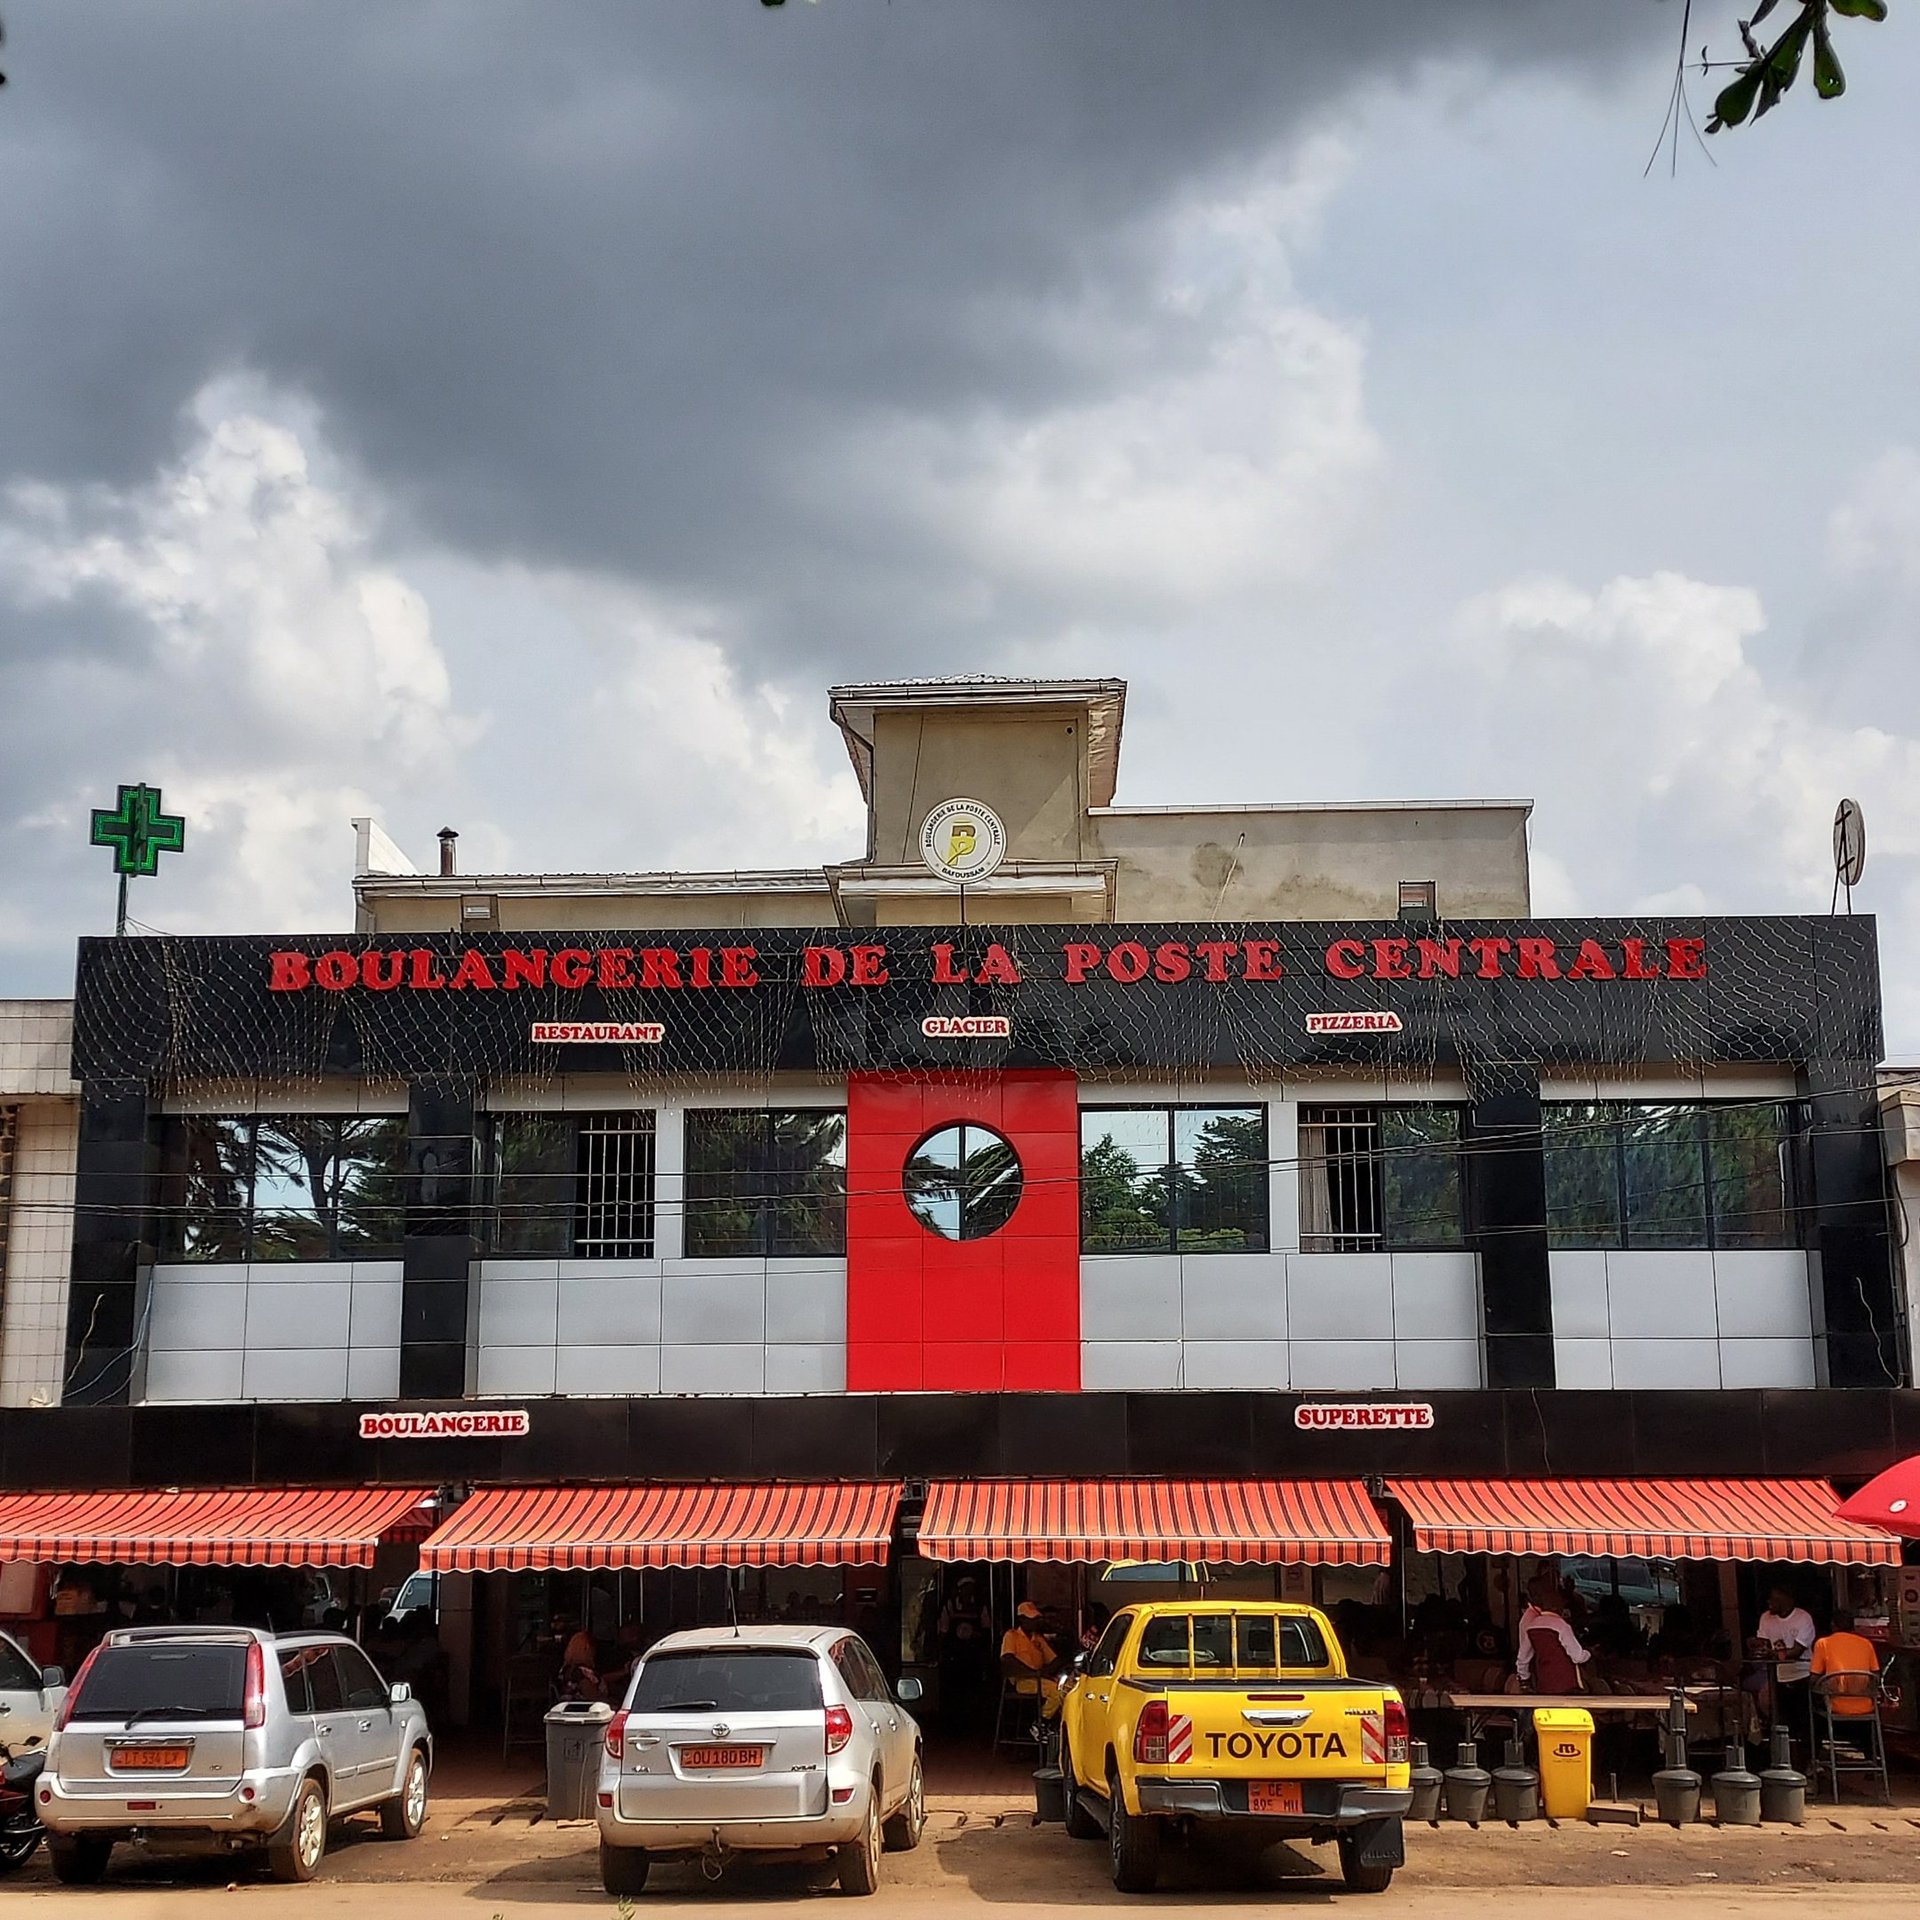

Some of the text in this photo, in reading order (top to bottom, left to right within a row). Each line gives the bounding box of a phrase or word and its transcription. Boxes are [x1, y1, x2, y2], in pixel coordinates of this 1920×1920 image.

[956, 803, 964, 811] LA
[941, 866, 986, 879] BAFOUSSAM
[268, 936, 1707, 991] BOULANGERIE DE LA POSTE CENTRALE
[923, 1018, 1008, 1035] GLACIER
[1308, 1014, 1400, 1031] PIZZERIA
[533, 1024, 662, 1042] RESTAURANT
[363, 1415, 525, 1435] BOULANGERIE
[1298, 1408, 1430, 1426] SUPERETTE
[1205, 1732, 1347, 1759] TOYOTA
[738, 1750, 757, 1764] BH
